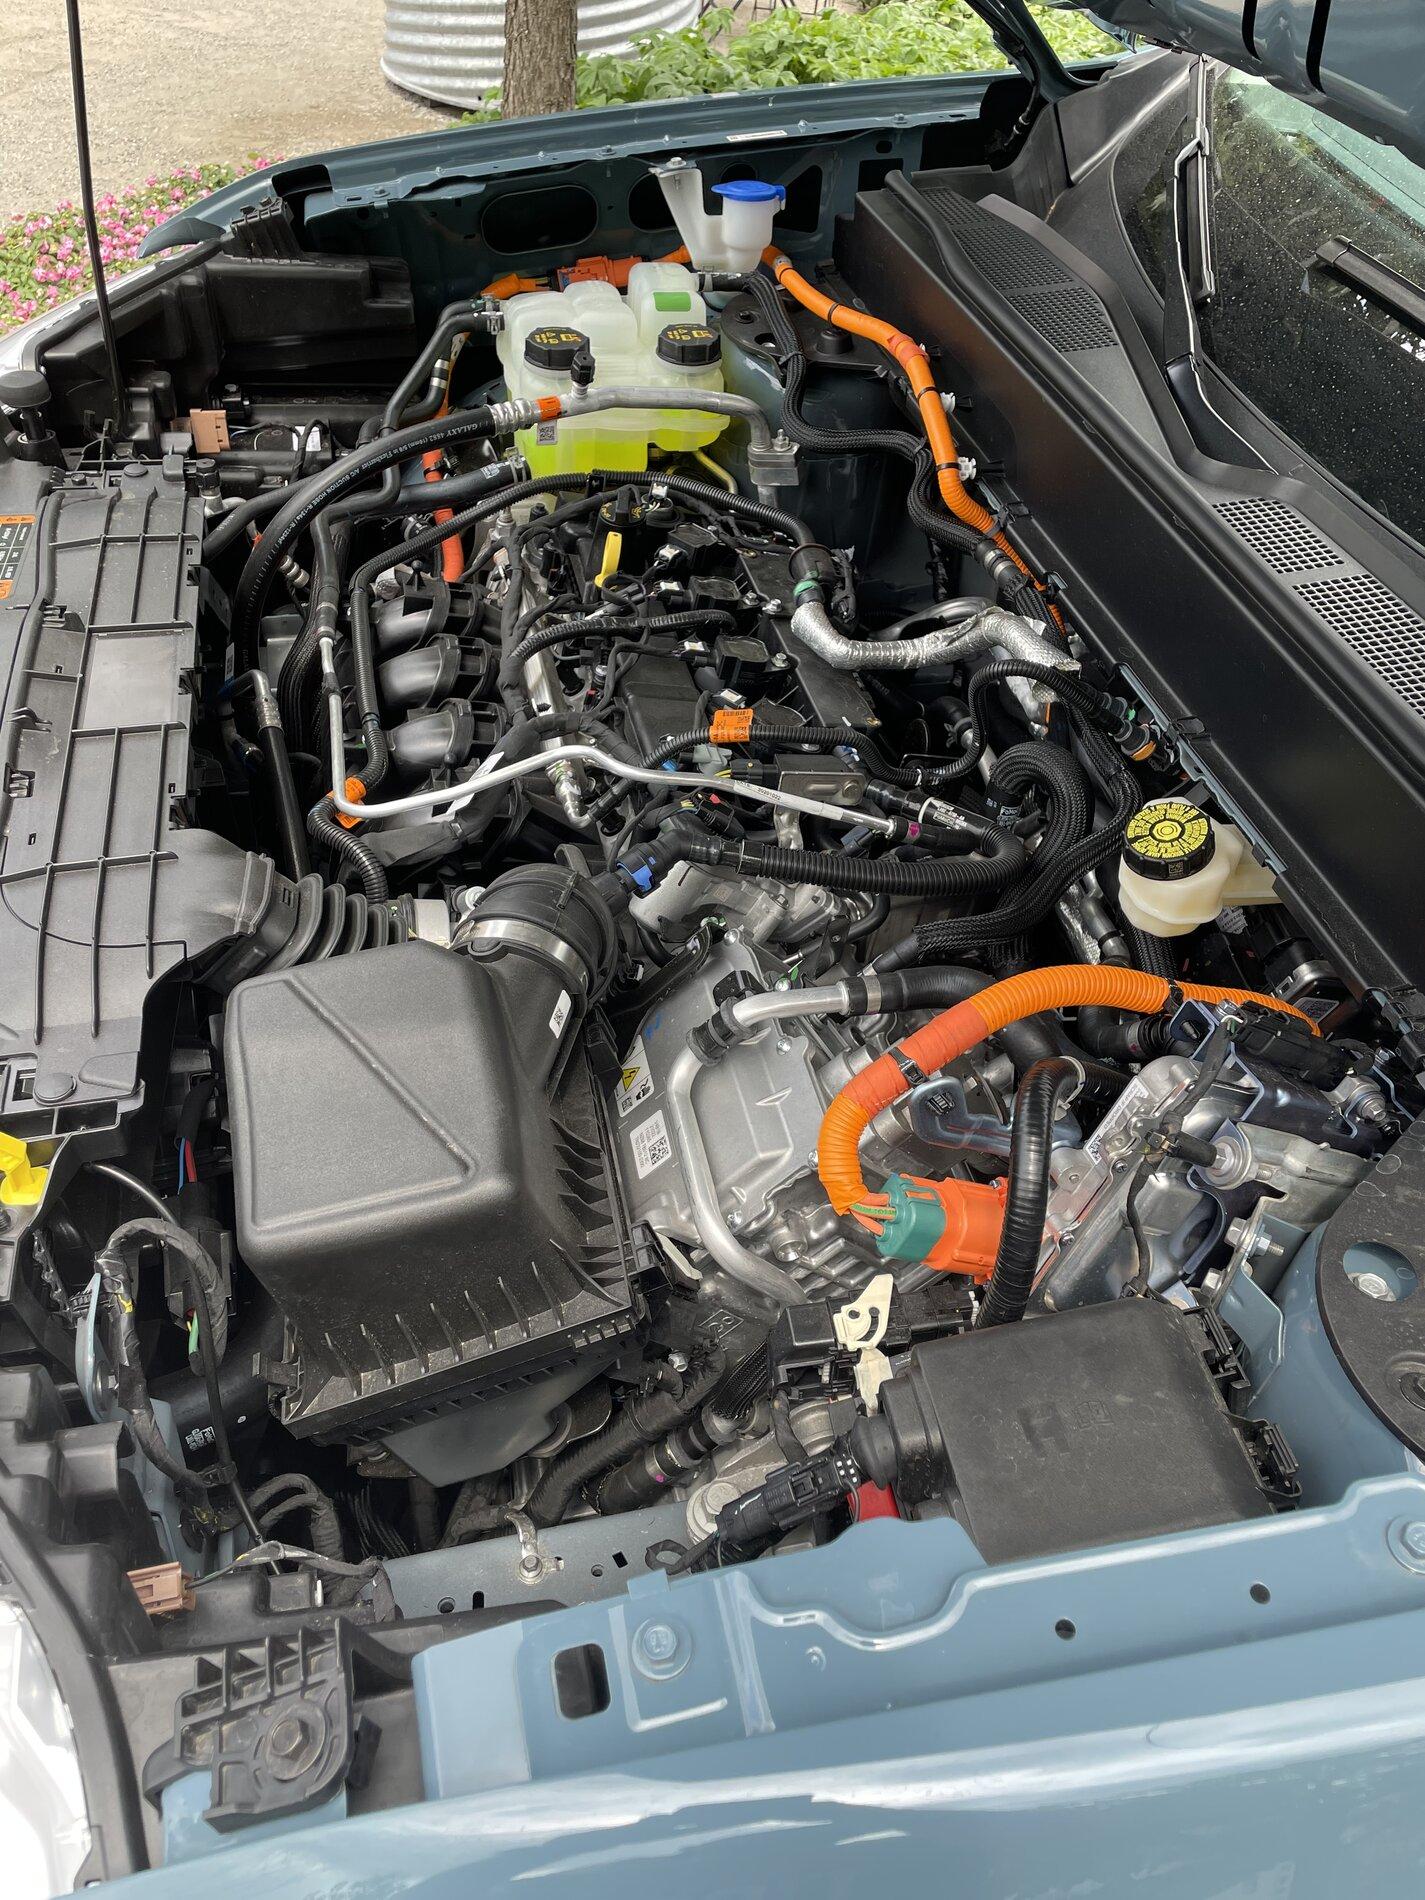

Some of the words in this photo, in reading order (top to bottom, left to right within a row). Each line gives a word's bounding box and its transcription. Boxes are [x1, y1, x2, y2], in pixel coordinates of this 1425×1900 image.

[447, 423, 478, 435] GALAXY
[349, 468, 359, 477] A/C
[326, 474, 349, 492] SUCTION
[311, 491, 326, 505] HOSE
